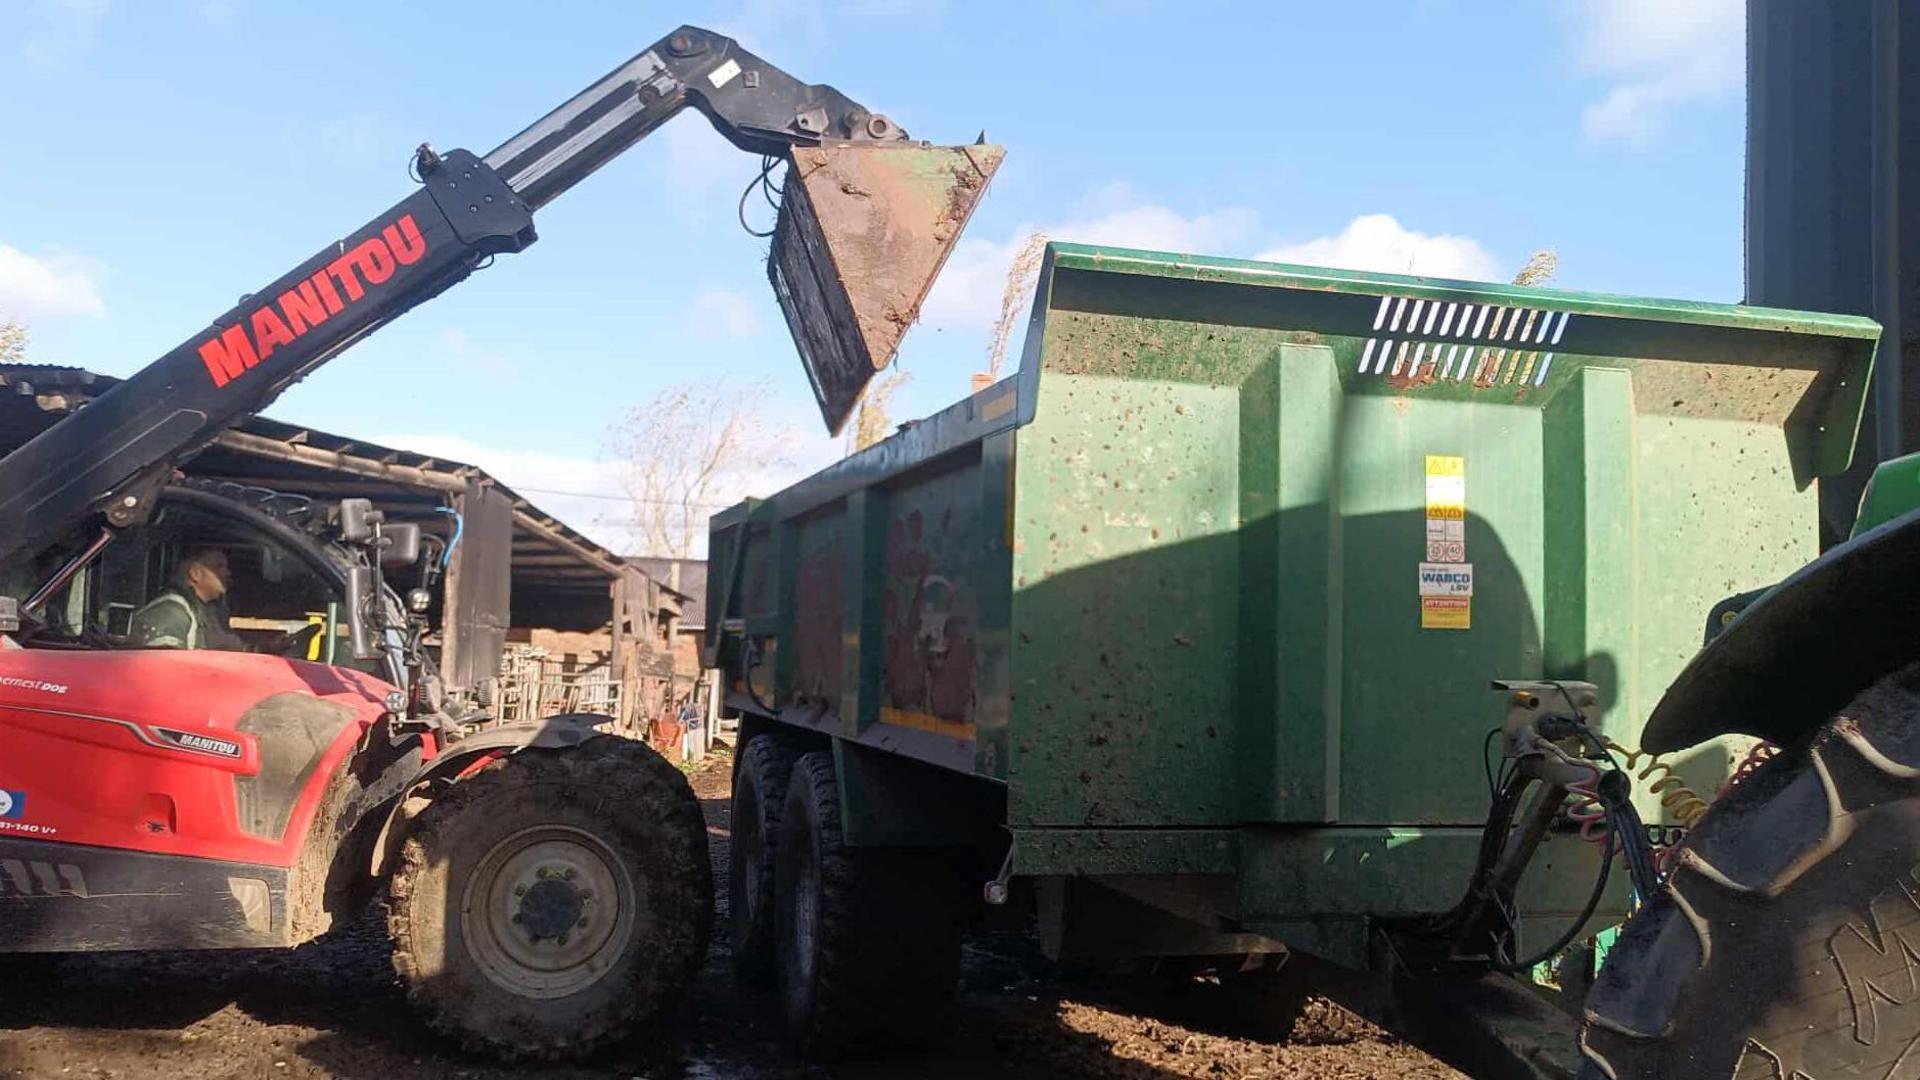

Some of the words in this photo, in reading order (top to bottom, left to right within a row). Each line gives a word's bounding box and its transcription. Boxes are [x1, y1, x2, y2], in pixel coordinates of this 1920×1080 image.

[198, 213, 427, 388] MANITOU
[1422, 573, 1470, 584] WABCO
[180, 734, 237, 754] MANITOU
